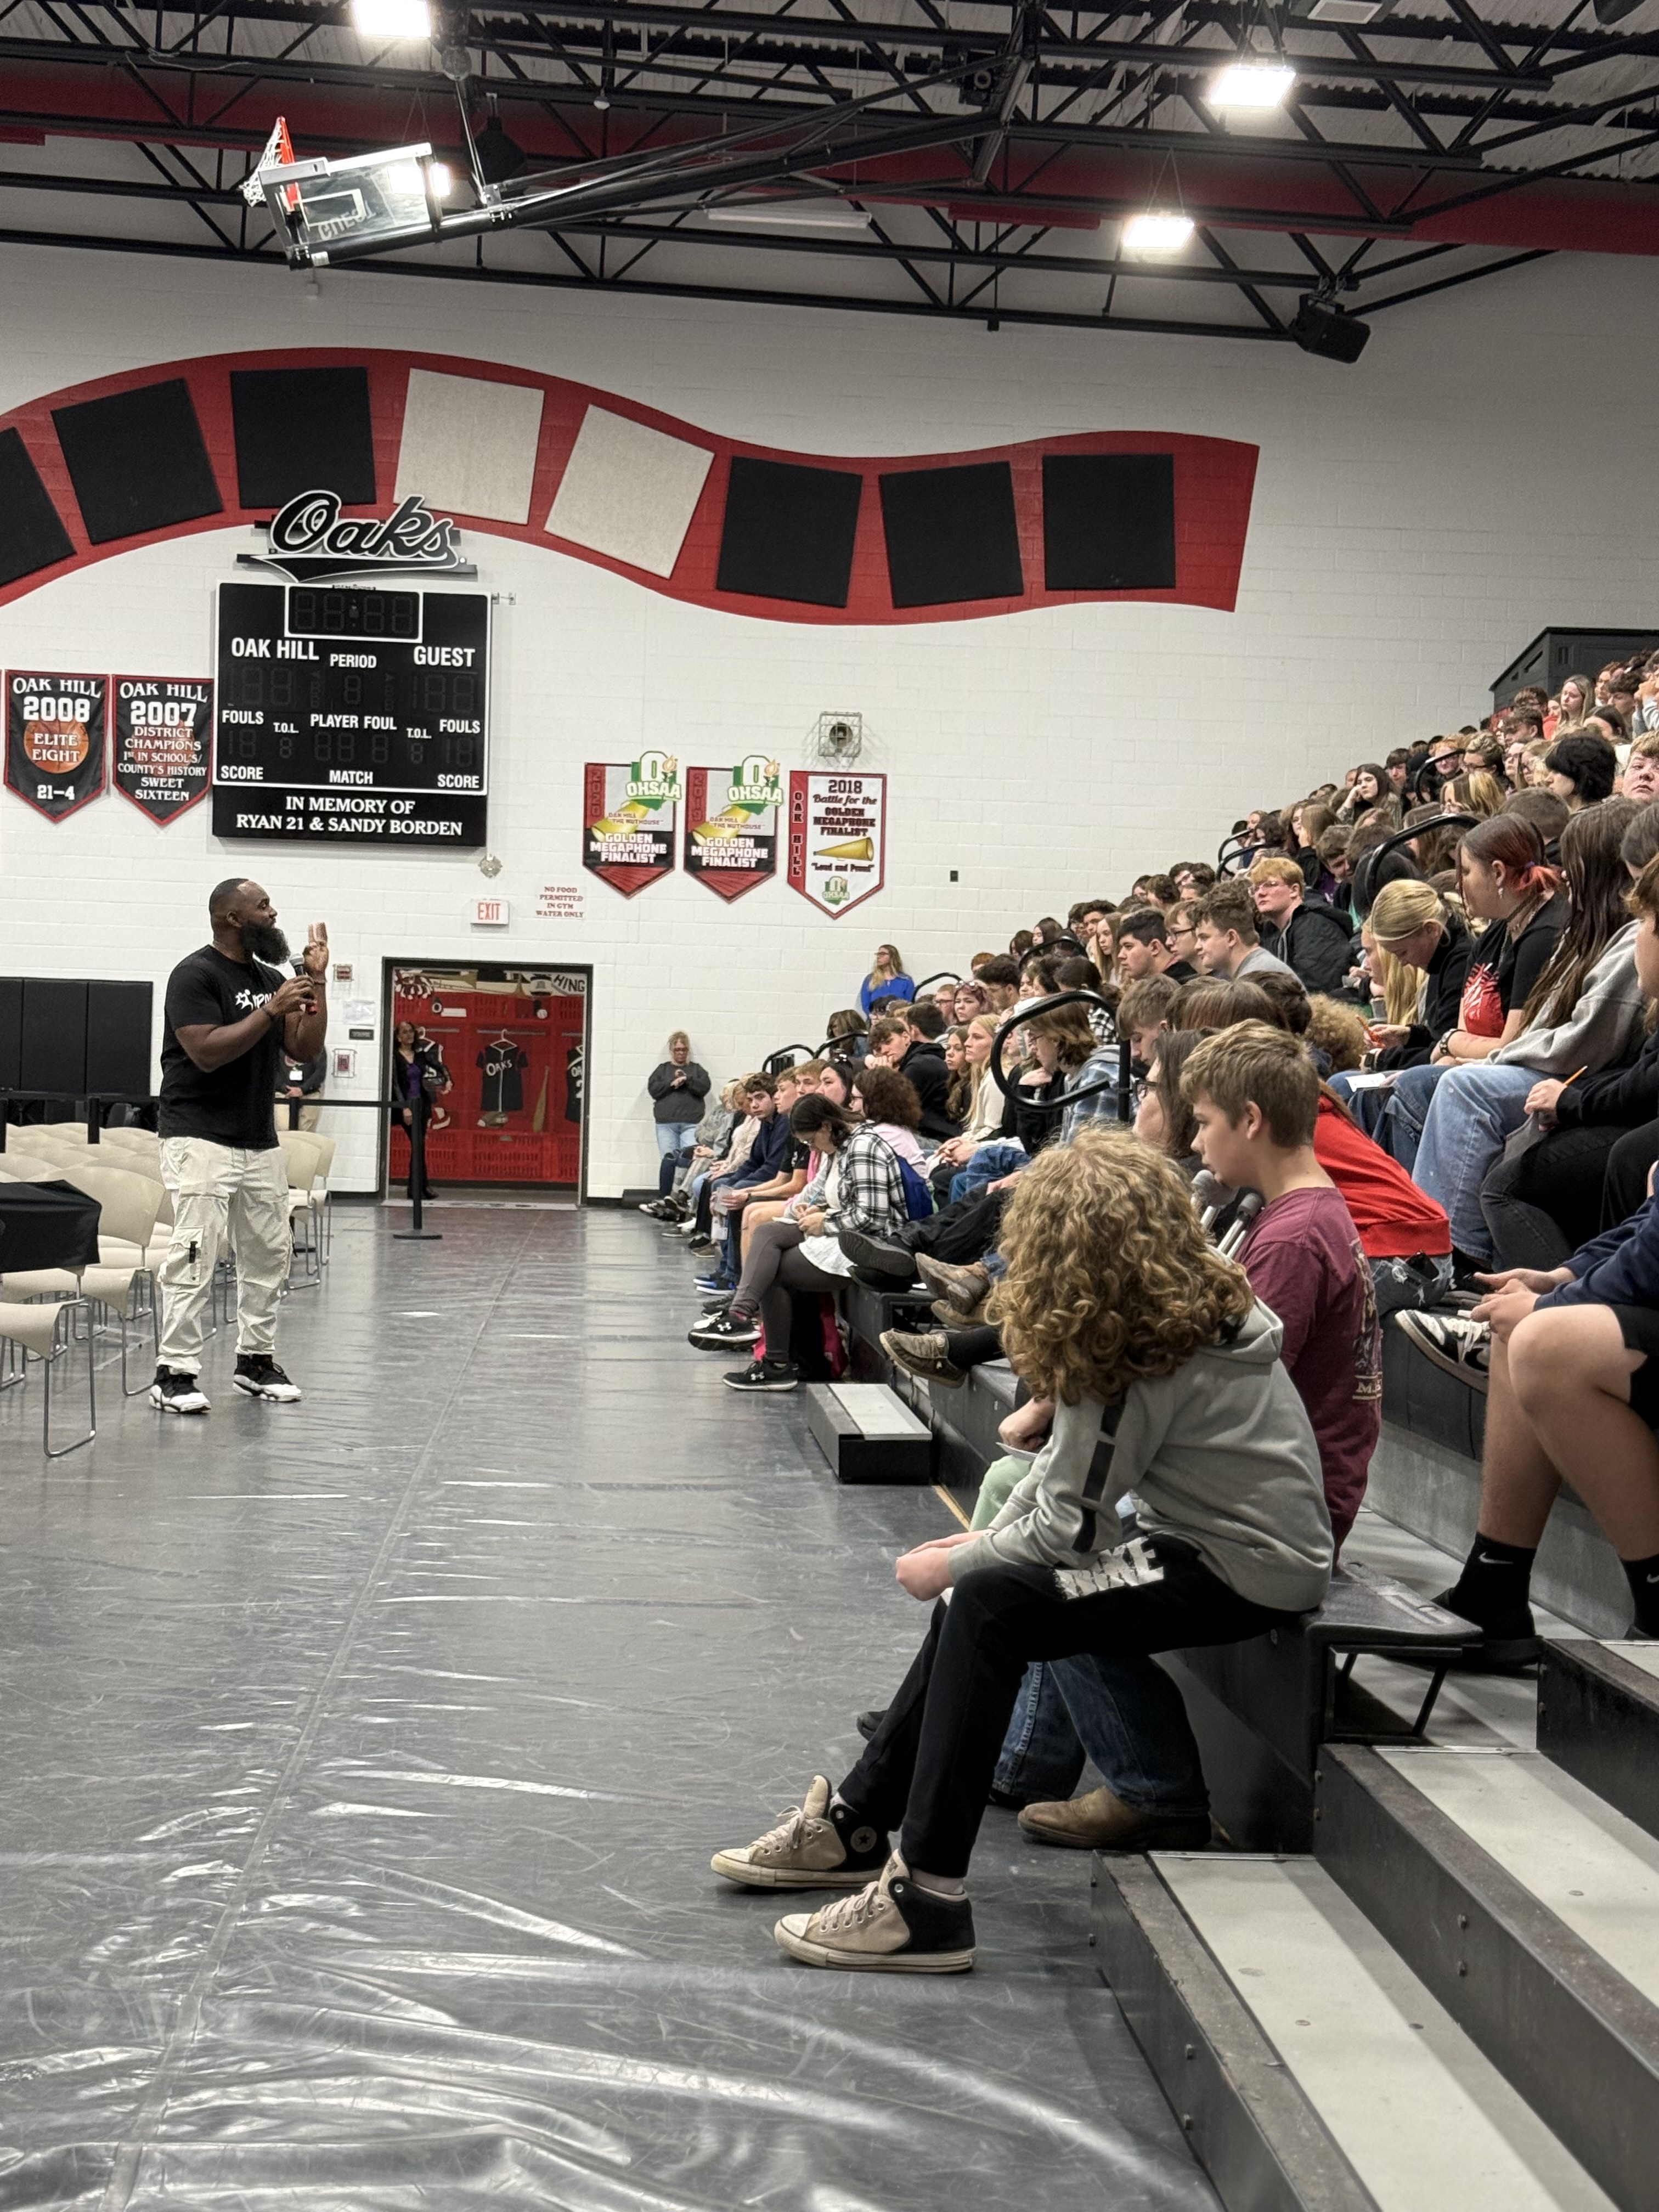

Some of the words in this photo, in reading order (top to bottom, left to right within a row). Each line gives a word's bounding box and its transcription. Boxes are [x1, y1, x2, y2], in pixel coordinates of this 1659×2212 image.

[270, 489, 454, 561] Oaks
[232, 637, 270, 658] OAK
[276, 641, 319, 660] HILL
[330, 653, 377, 668] PERIOD
[414, 646, 476, 667] GUEST
[13, 678, 52, 694] OAK
[60, 679, 101, 698] HILL
[120, 682, 159, 699] OAK
[167, 684, 208, 703] HILL
[24, 696, 90, 723] 2008
[131, 701, 197, 727] 2007
[222, 710, 263, 724] FOULS
[311, 714, 359, 729] PLAYER
[364, 716, 397, 730] FOUL
[134, 727, 193, 738] DISTRICT
[274, 722, 298, 733] T.O.L.
[439, 719, 480, 733] FOULS
[34, 733, 78, 746] ELITE
[407, 728, 432, 739] T.O.L.
[125, 739, 201, 751] CHAMPIONS
[32, 749, 80, 763] EIGHT
[138, 752, 148, 761] IN
[117, 763, 164, 775] COUNTY'S
[167, 766, 207, 776] HISTORY
[221, 766, 263, 780] SCORE
[141, 777, 184, 788] SWEET
[330, 770, 373, 785] MATCH
[438, 775, 479, 788] SCORE
[626, 781, 681, 800] OHSAA
[828, 780, 862, 794] 2018
[135, 789, 189, 801] SIXTEEN
[727, 786, 783, 805] OHSAA
[812, 794, 843, 804] Battle
[843, 795, 860, 806] for
[862, 796, 877, 805] the
[286, 797, 304, 810] IN
[309, 798, 386, 812] MEMORY
[391, 800, 415, 814] OF
[793, 791, 804, 823] OAK
[825, 807, 865, 817] GOLDEN
[236, 815, 282, 829] RYAN
[287, 816, 303, 830] 21
[310, 817, 323, 831] &
[328, 818, 386, 834] SANDY
[390, 820, 462, 836] BORDEN
[813, 816, 876, 827] MEGAPHONE
[606, 833, 653, 844] GOLDEN
[820, 827, 868, 836] FINALIST
[590, 842, 667, 854] MEGAPHONE
[707, 837, 754, 848] GOLDEN
[601, 852, 656, 864] FINALIST
[691, 846, 769, 859] MEGAPHONE
[793, 834, 803, 877] HILL
[702, 856, 758, 868] FINALIST
[478, 902, 500, 920] EXIT
